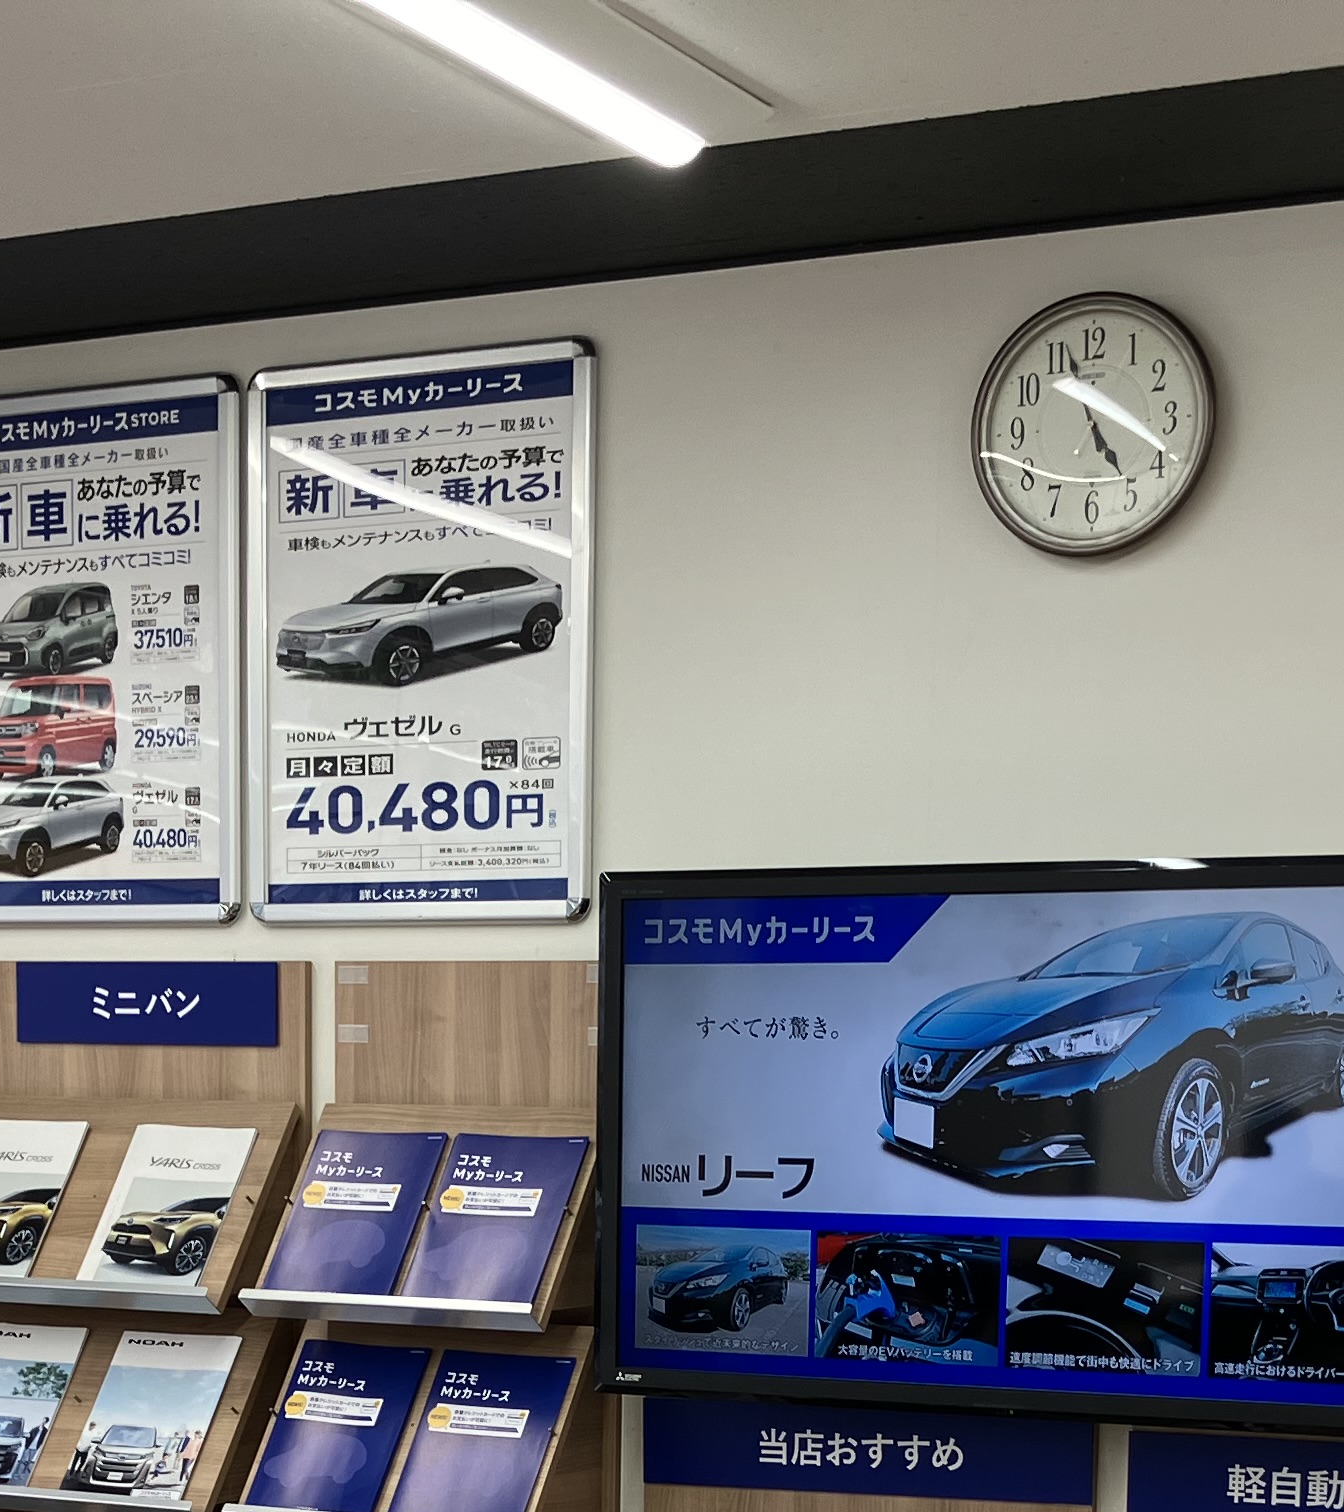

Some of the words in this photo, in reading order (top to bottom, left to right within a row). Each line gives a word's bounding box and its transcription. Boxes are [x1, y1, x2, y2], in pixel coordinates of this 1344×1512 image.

[1047, 341, 1064, 375] 11
[1082, 326, 1106, 361] 12
[1128, 333, 1138, 366] 1
[1017, 373, 1040, 407] 10
[1151, 359, 1167, 392] 2
[315, 373, 523, 413] コスモMyカーリース
[1162, 400, 1178, 435] 3
[1010, 417, 1025, 450] 9
[411, 446, 564, 476] あなたの予算で
[1020, 457, 1035, 491] 8
[77, 469, 201, 500] あなたの予算で
[1123, 477, 1137, 512] 5
[1047, 484, 1062, 518] 7
[1084, 490, 1099, 524] 6
[77, 501, 201, 543] に乗れる!
[131, 591, 172, 606] シエンタ
[131, 690, 183, 706] スペーシア
[286, 732, 337, 743] HONDA
[344, 715, 443, 741] ヴェゼル
[450, 724, 462, 736] G
[286, 780, 544, 835] 40,480円
[132, 828, 198, 849] 40,480円
[41, 888, 132, 902] 詳しくはスタッフまで!
[359, 888, 479, 901] 詳しくはスタッフまで!
[643, 915, 876, 947] コスモMyカーリース
[91, 986, 201, 1020] ミニバン
[695, 1014, 843, 1041] すべてが驚き。
[316, 1163, 383, 1178] Myカーリース
[320, 1150, 354, 1163] コスモ
[457, 1154, 492, 1167] コスモ
[452, 1168, 524, 1182] Myカーリース
[641, 1162, 691, 1184] NISSAN
[698, 1153, 815, 1197] リーフ
[128, 1338, 185, 1349] NOAH
[837, 1344, 973, 1361] 大容量のEVバッテリーを搭載
[297, 1374, 366, 1391] Myカーリース
[301, 1360, 335, 1374] コスモ
[444, 1372, 479, 1385] コスモ
[440, 1385, 511, 1402] Myカーリース
[758, 1428, 965, 1471] 当店おすすめ
